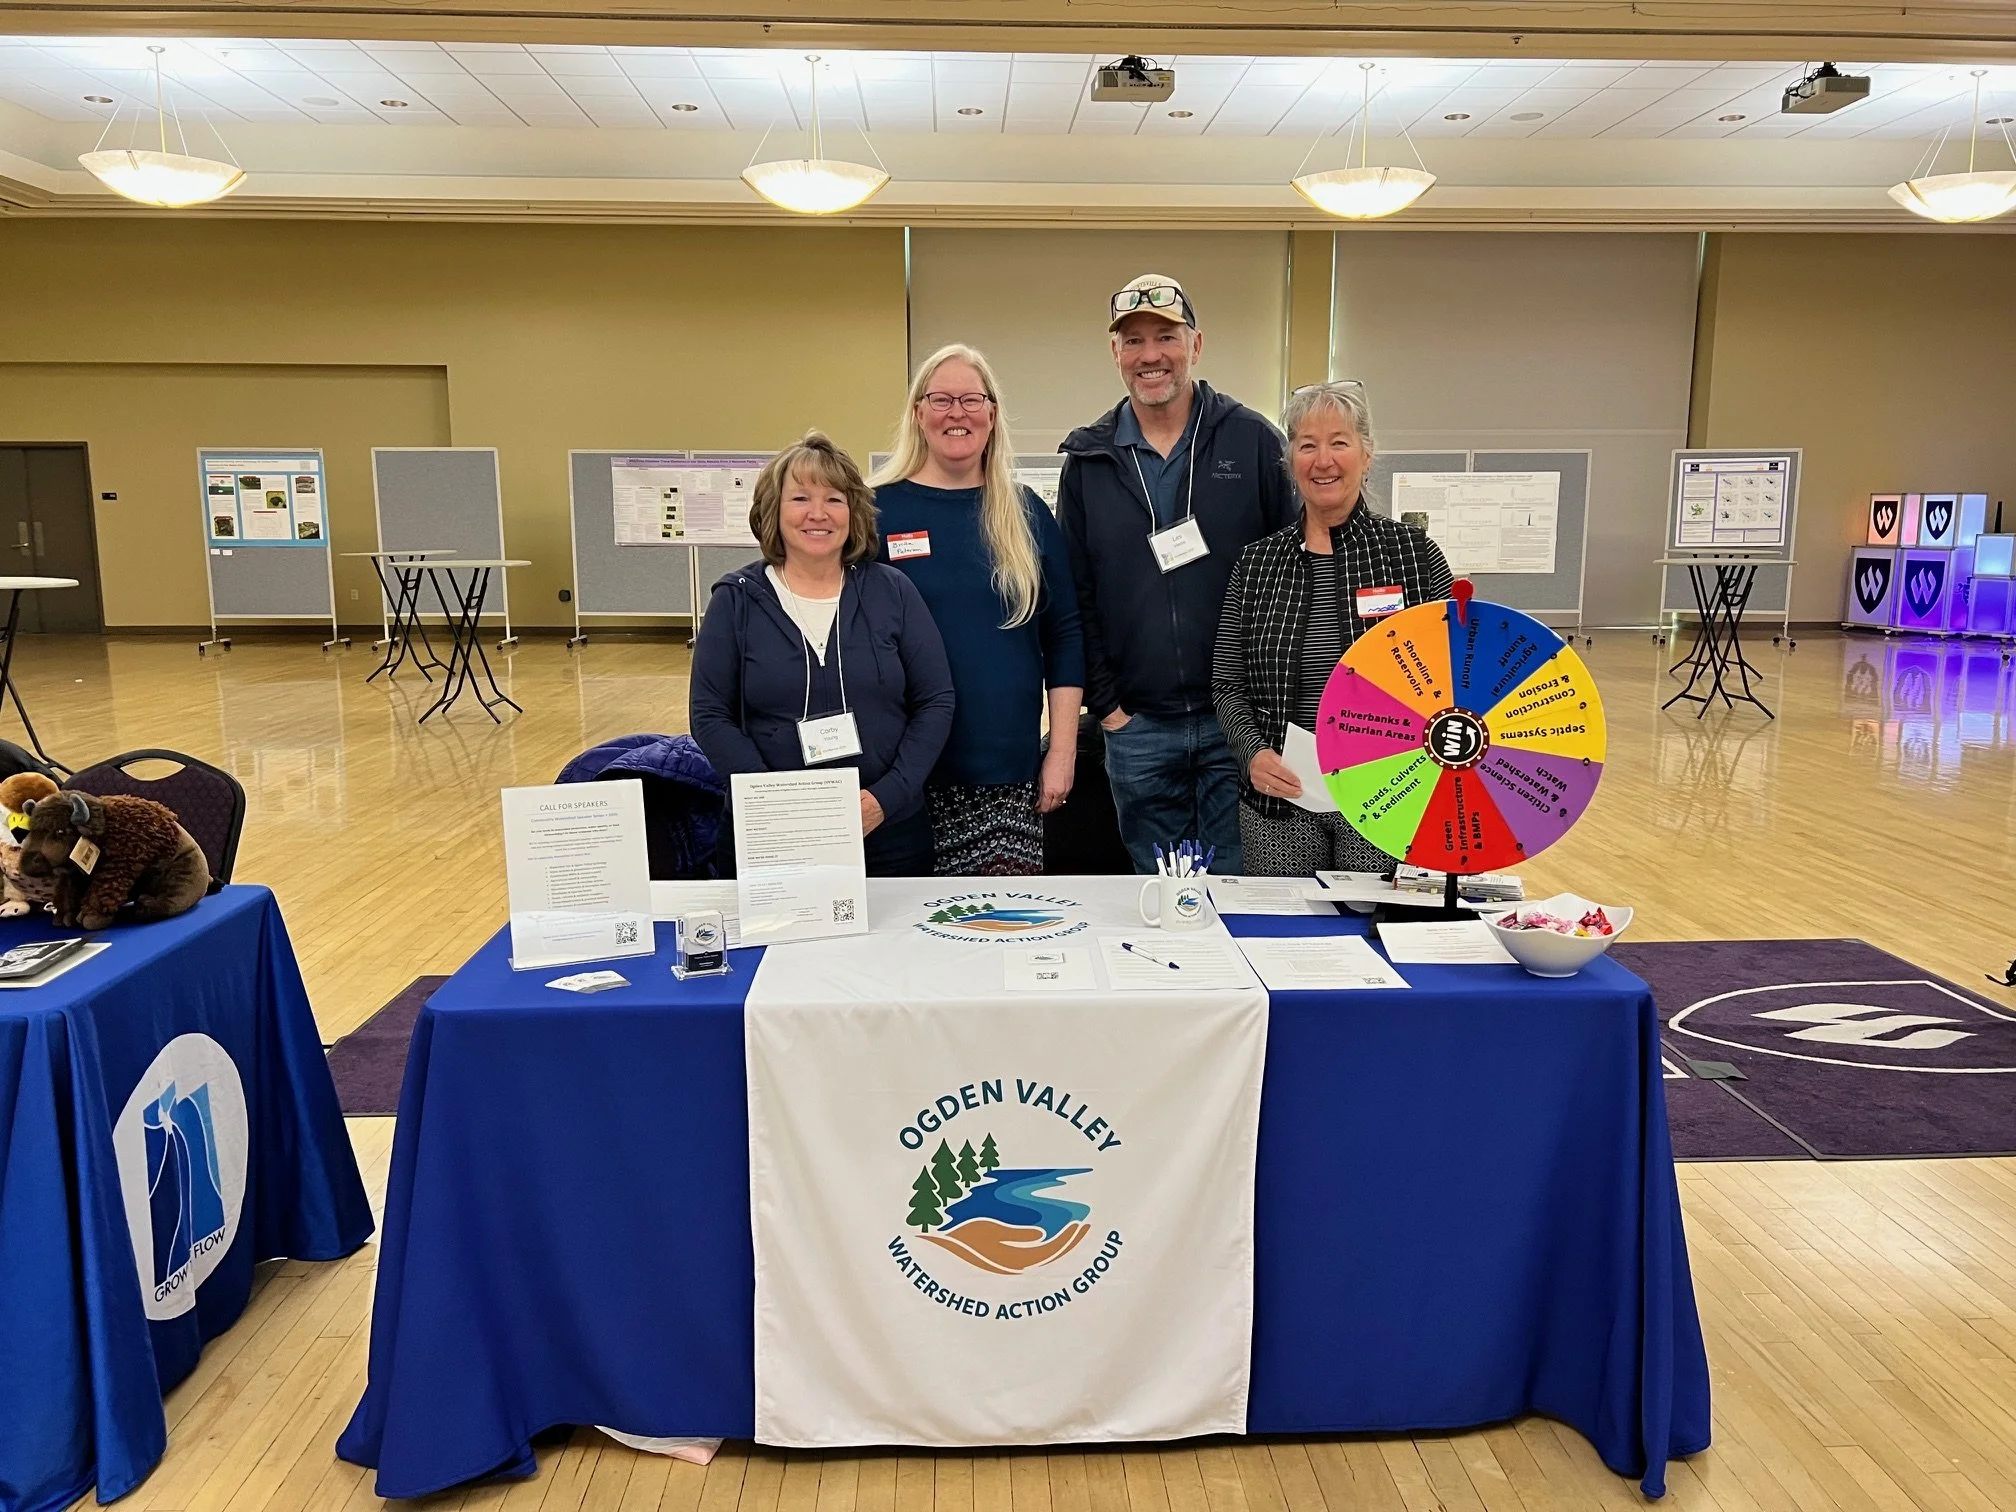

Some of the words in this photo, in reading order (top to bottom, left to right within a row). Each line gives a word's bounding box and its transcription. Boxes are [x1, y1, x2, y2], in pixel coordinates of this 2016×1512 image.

[1468, 618, 1479, 651] Urban
[1498, 635, 1526, 667] Runoff
[1391, 646, 1424, 697] Reservoirs
[1403, 640, 1433, 685] Shoreline
[1433, 689, 1442, 700] &
[1461, 653, 1474, 689] Runoff
[1491, 643, 1538, 697] Agricultural
[1561, 674, 1570, 683] &
[1506, 688, 1576, 718] Construction
[1518, 678, 1560, 698] Erosion
[1339, 722, 1382, 737] Riparian
[1385, 730, 1416, 742] Areas
[1341, 709, 1400, 725] Riverbanks
[1402, 718, 1411, 727] &
[1550, 724, 1585, 734] Septic
[1500, 728, 1547, 740] Systems
[1362, 786, 1392, 810] Roads,
[1390, 754, 1427, 786] Culverts
[1480, 762, 1517, 790] Science
[1496, 758, 1549, 797] Watershed
[1536, 766, 1568, 792] Watch
[1372, 810, 1382, 820] &
[1380, 778, 1422, 813] Sediment
[1516, 787, 1550, 813] Citizen
[1551, 792, 1560, 802] &
[1454, 776, 1468, 850] Infrastructure
[1471, 812, 1482, 839] BMPs
[1444, 820, 1454, 851] Green
[1474, 841, 1482, 849] &
[923, 892, 997, 908] OGDEN
[1005, 892, 1083, 908] VALLEY
[912, 922, 990, 943] WATERSHED
[994, 933, 1054, 943] ACTION
[1052, 920, 1091, 938] GROUP
[899, 1078, 1003, 1150] OGDEN
[1015, 1078, 1122, 1154] VALLEY
[154, 1264, 188, 1302] GROW
[194, 1228, 226, 1258] FLOW
[887, 1235, 990, 1318] WATERSHED
[996, 1288, 1072, 1320] ACTION
[1072, 1230, 1125, 1294] GROUP
